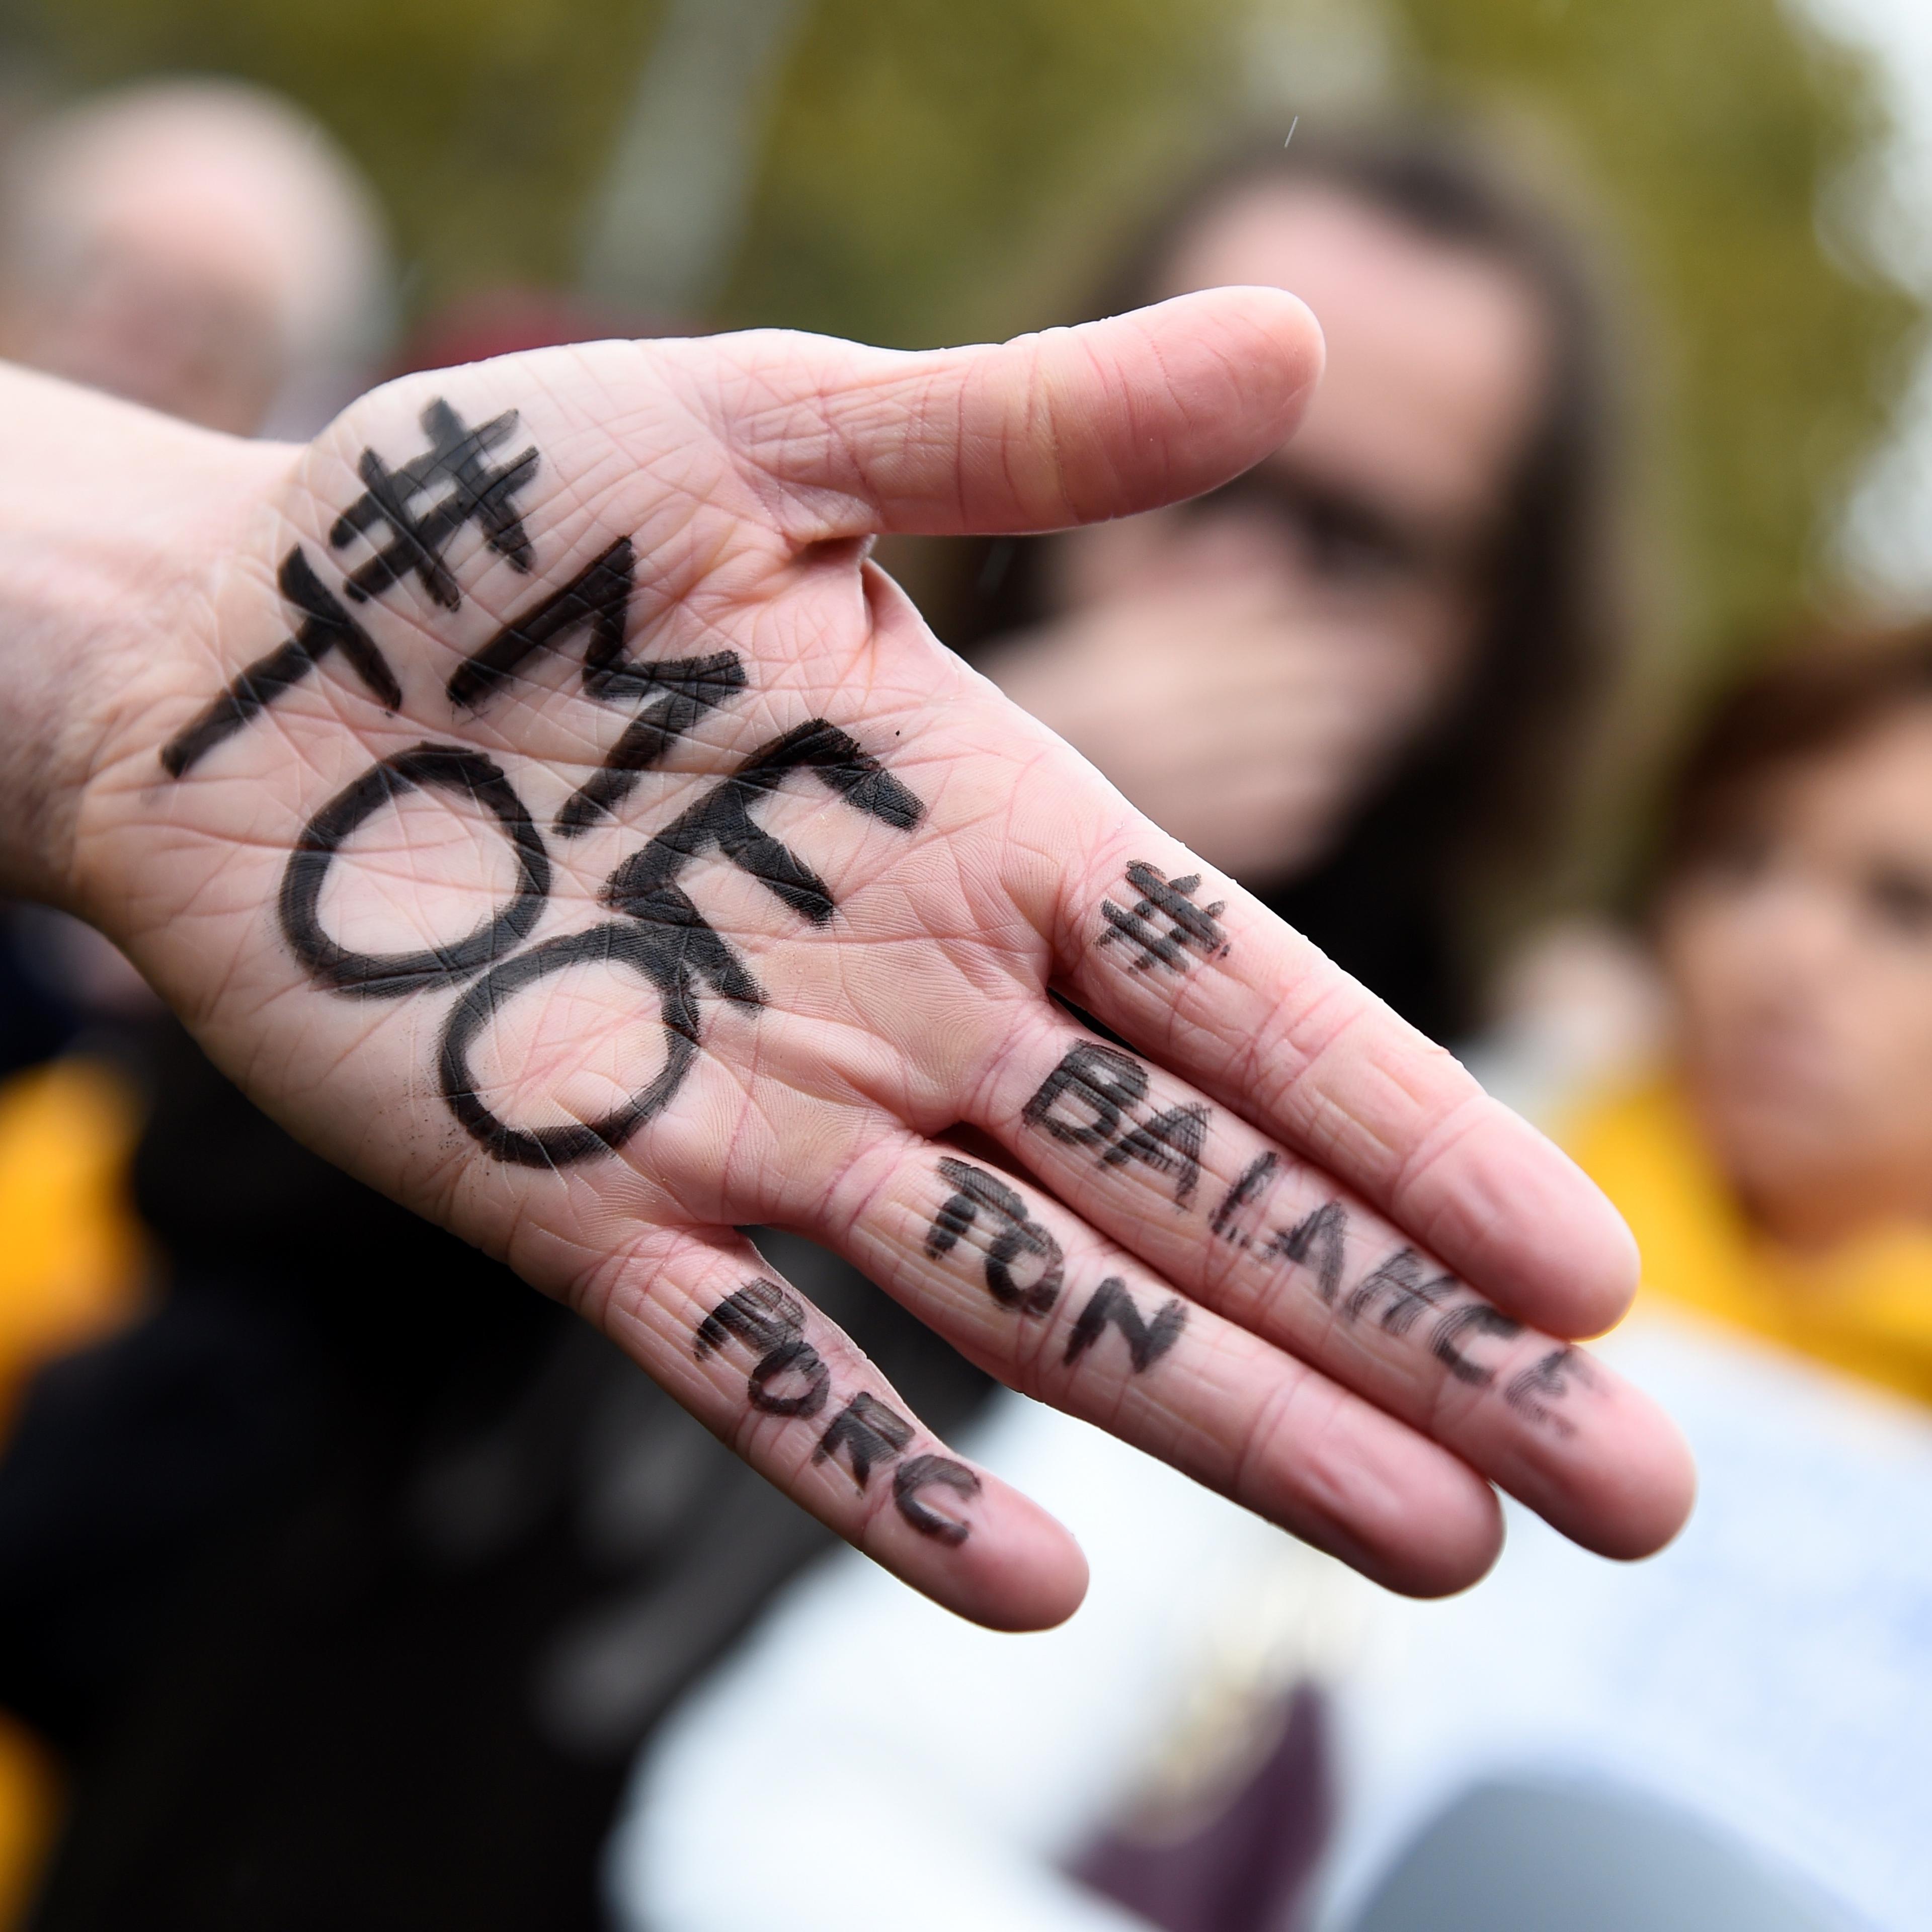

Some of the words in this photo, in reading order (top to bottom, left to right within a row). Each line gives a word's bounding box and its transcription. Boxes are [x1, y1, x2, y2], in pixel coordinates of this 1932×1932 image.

[159, 544, 701, 1169] TOO
[1094, 858, 1230, 976] #
[923, 1156, 1188, 1374] TON
[693, 1276, 982, 1548] PORC
